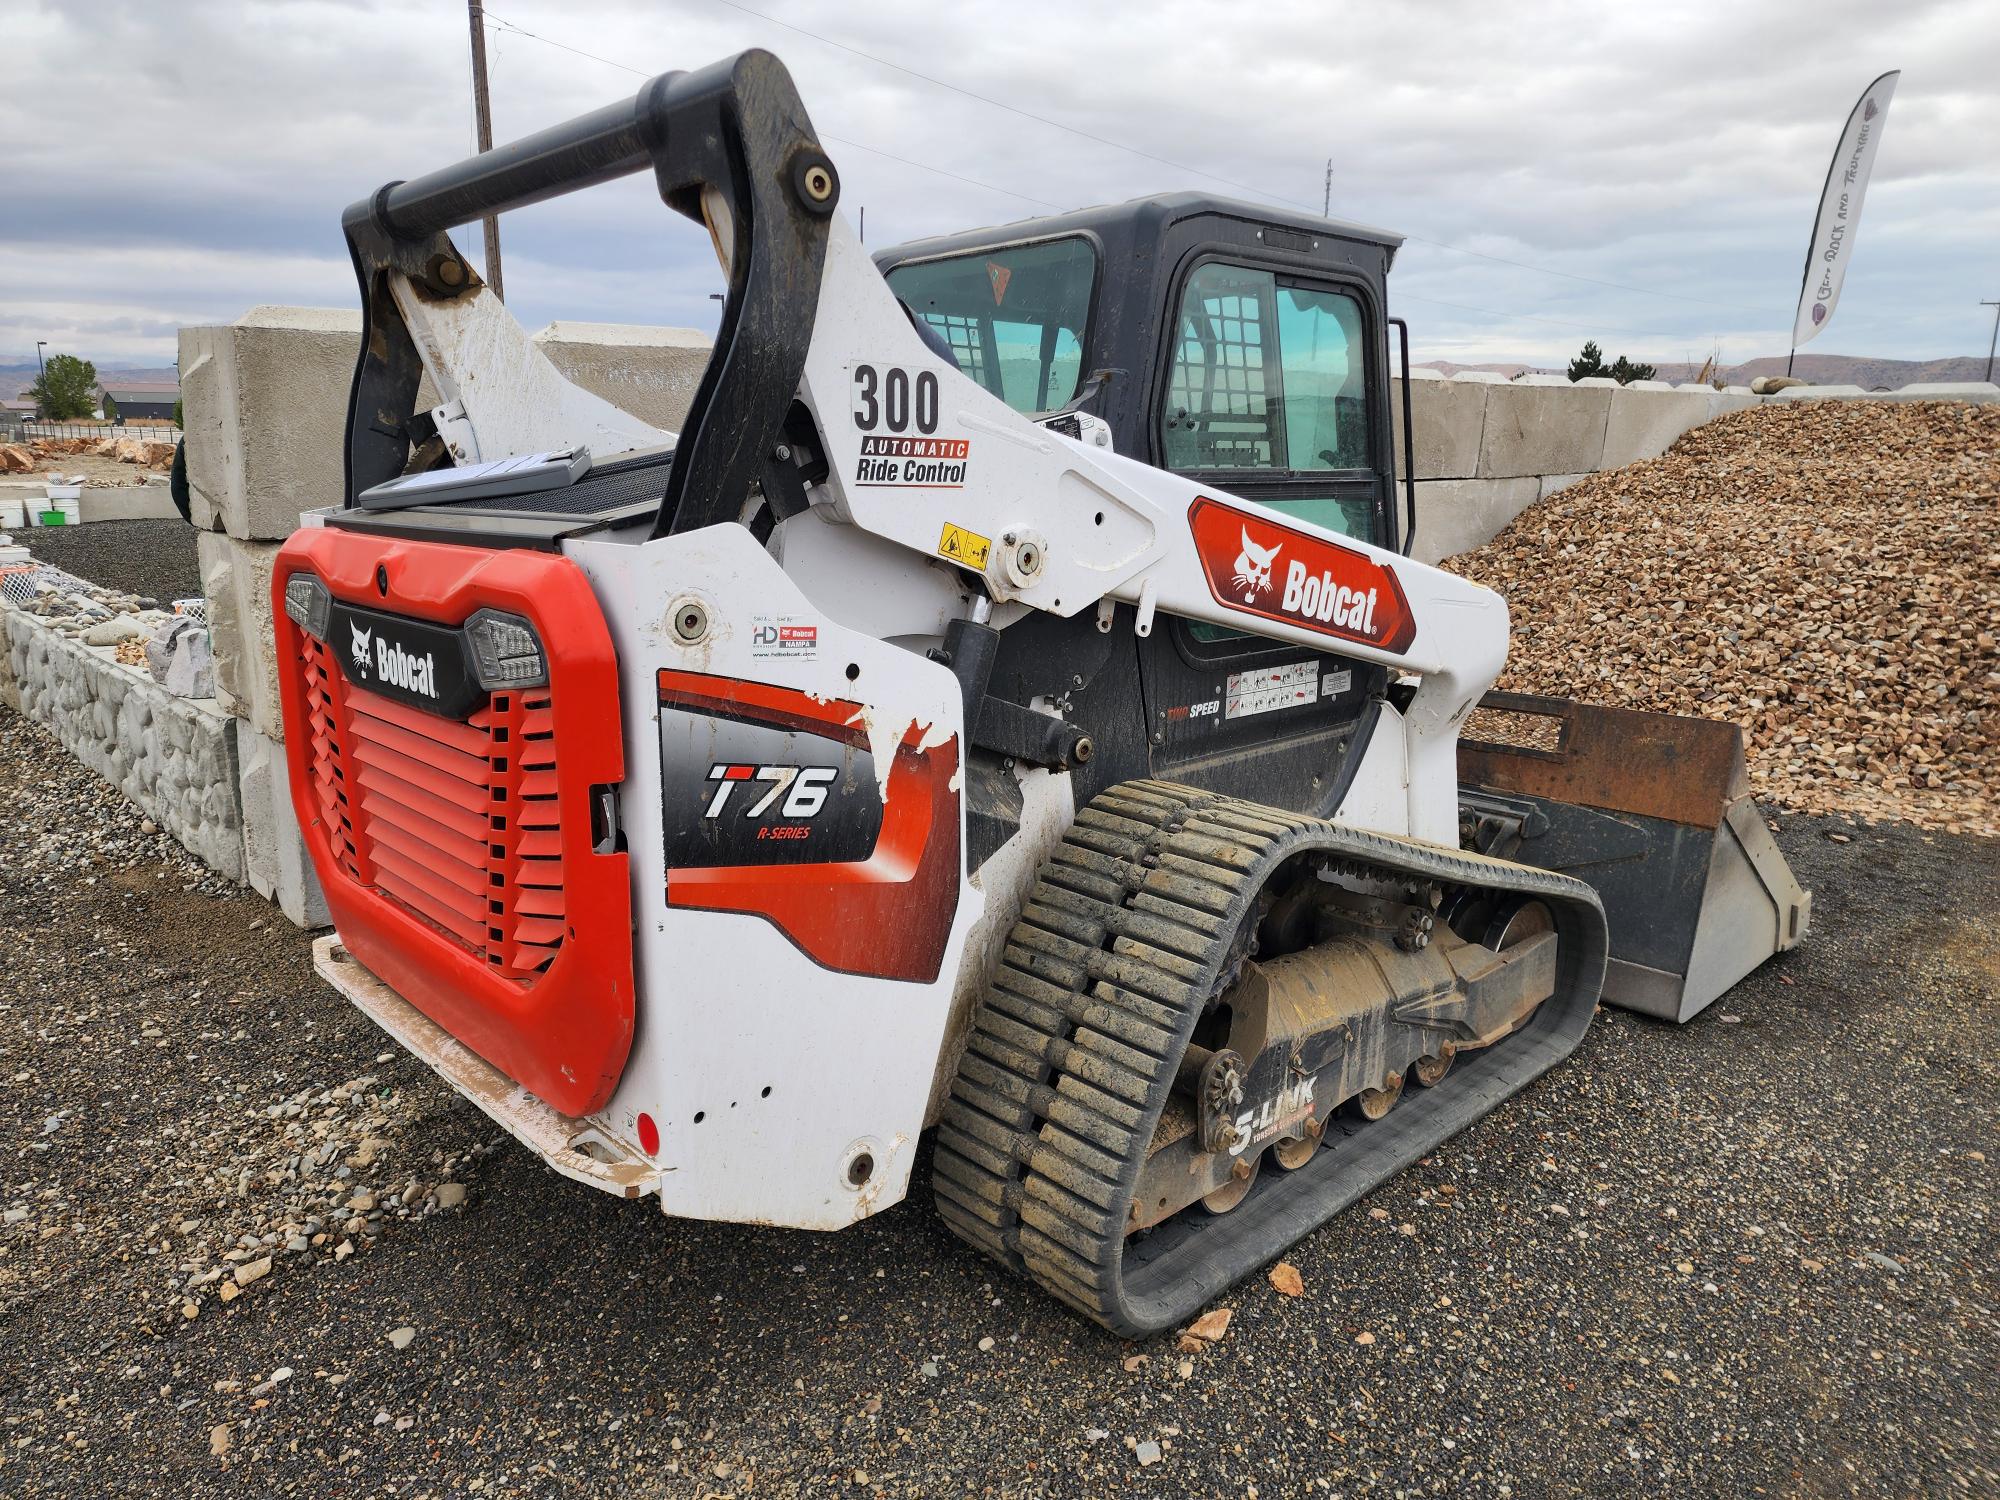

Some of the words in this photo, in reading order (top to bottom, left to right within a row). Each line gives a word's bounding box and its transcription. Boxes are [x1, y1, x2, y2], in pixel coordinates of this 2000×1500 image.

[854, 364, 939, 435] 300
[864, 438, 966, 458] AUTOMATIC
[856, 458, 899, 482] Ride
[903, 459, 968, 483] Control
[1282, 559, 1377, 635] Bobcat
[376, 637, 437, 699] Bobcat
[1190, 700, 1220, 718] SPEED
[704, 764, 839, 818] T76
[757, 826, 811, 840] R-SERIES
